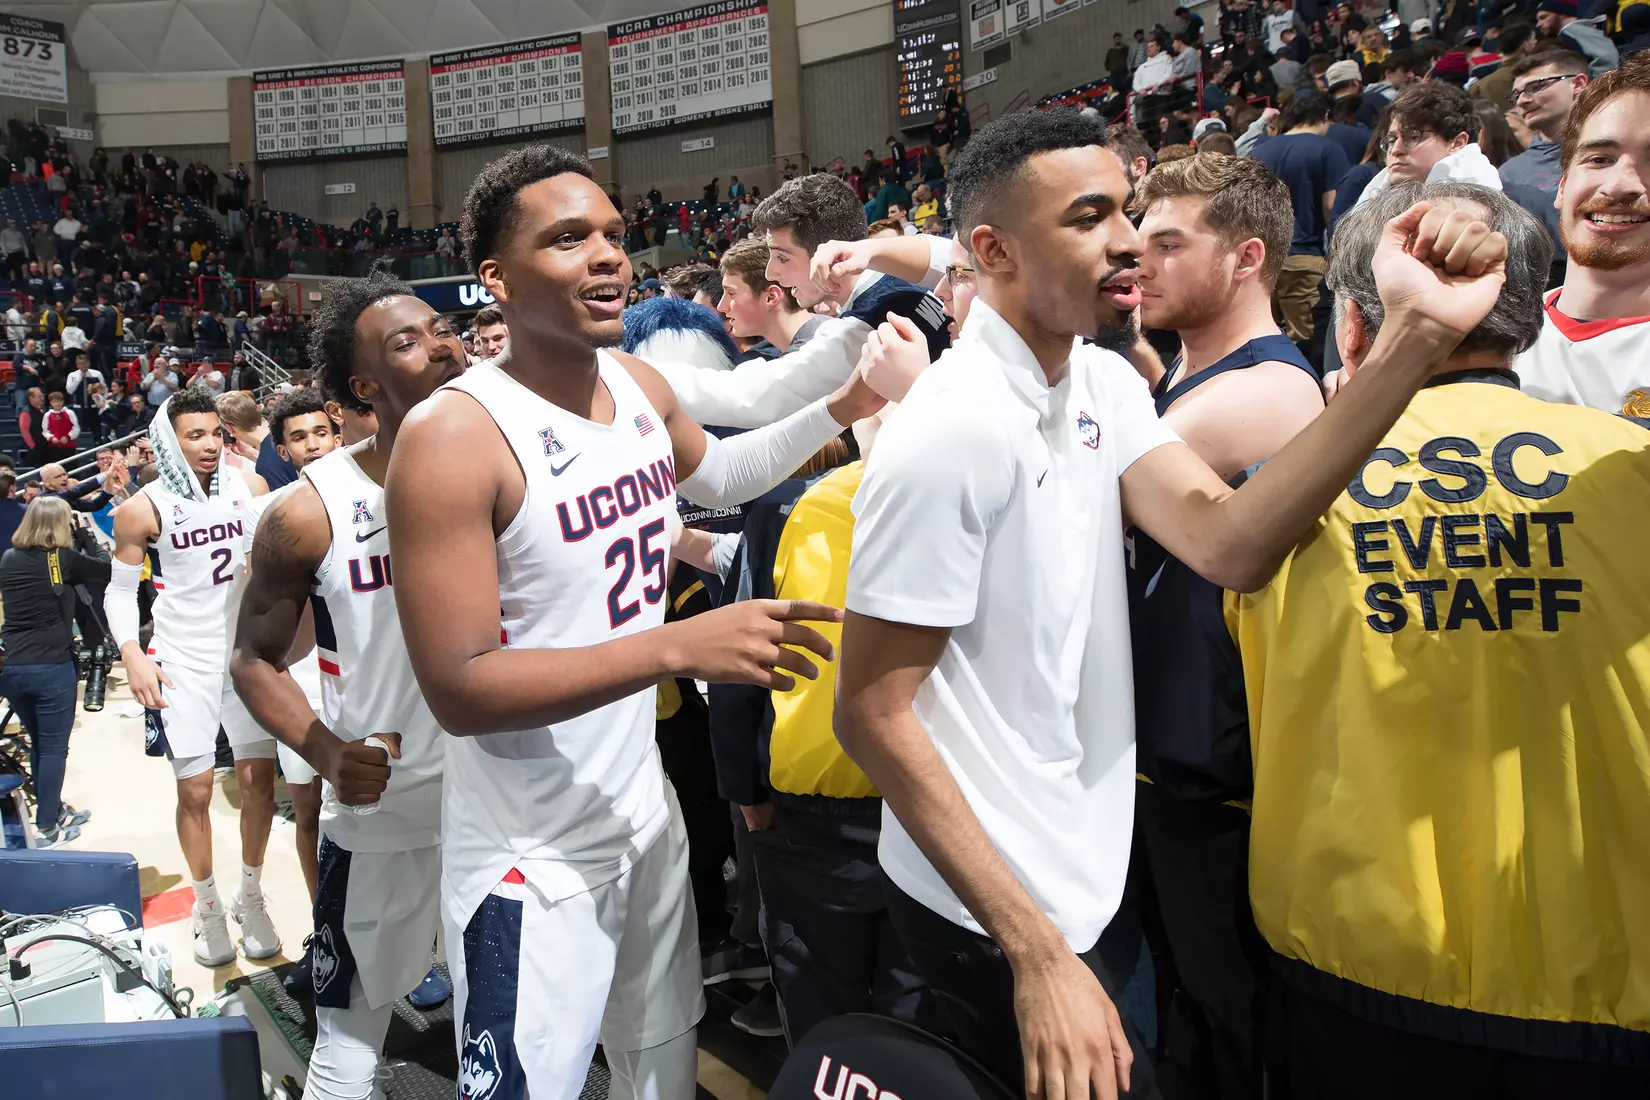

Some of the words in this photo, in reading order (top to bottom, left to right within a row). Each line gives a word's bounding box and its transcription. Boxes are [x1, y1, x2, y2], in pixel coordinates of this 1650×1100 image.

[10, 18, 43, 28] COACH
[616, 25, 681, 43] TOURNAMENT
[686, 7, 760, 28] APPEARANCES
[617, 20, 650, 34] NCAA
[657, 0, 757, 25] CHAMPIONSHIP
[13, 26, 58, 40] CALHOUN
[612, 47, 627, 58] 1989
[634, 42, 650, 53] 1990
[657, 38, 672, 48] 1991
[678, 33, 695, 44] 1992
[702, 28, 718, 39] 1993
[725, 24, 741, 35] 1994
[749, 18, 765, 30] 1995
[4, 37, 52, 60] 873
[444, 56, 506, 71] TOURNAMENT
[511, 47, 567, 61] CHAMPIONS
[470, 48, 502, 58] AMERICAN
[504, 43, 534, 53] ATHLETIC
[536, 35, 578, 48] CONFERENCE
[613, 64, 628, 74] 1996
[635, 59, 650, 70] 1997
[657, 54, 673, 65] 1998
[680, 50, 696, 61] 1999
[702, 45, 720, 56] 2000
[725, 40, 743, 52] 2001
[749, 35, 767, 47] 2002
[294, 69, 326, 77] AMERICAN
[328, 66, 358, 74] ATHLETIC
[360, 63, 401, 71] CONFERENCE
[305, 77, 342, 85] SEASON
[346, 72, 402, 81] CHAMPIONS
[434, 76, 450, 86] 1989
[456, 73, 470, 83] 1991
[477, 69, 492, 79] 1994
[498, 66, 514, 76] 1995
[520, 63, 535, 73] 1996
[542, 59, 557, 69] 1997
[563, 56, 579, 66] 1998
[613, 81, 630, 92] 2003
[635, 76, 652, 87] 2004
[657, 72, 674, 83] 2005
[680, 67, 697, 78] 2006
[703, 62, 720, 73] 2007
[726, 57, 744, 69] 2008
[750, 52, 768, 64] 2009
[980, 70, 998, 83] 201
[258, 92, 272, 102] 1989
[279, 91, 294, 100] 1990
[301, 89, 315, 98] 1991
[322, 87, 337, 97] 1994
[343, 85, 358, 95] 1995
[365, 83, 380, 93] 1996
[387, 81, 402, 91] 1997
[436, 92, 451, 102] 1999
[456, 89, 472, 99] 2000
[478, 86, 493, 96] 2001
[498, 82, 515, 93] 2002
[520, 78, 536, 89] 2005
[542, 75, 559, 86] 2006
[564, 72, 581, 83] 2008
[615, 97, 631, 108] 2010
[637, 93, 652, 104] 2011
[659, 88, 675, 100] 2012
[682, 84, 697, 95] 2013
[704, 79, 721, 91] 2014
[727, 75, 744, 87] 2015
[751, 70, 768, 82] 2016
[258, 108, 273, 117] 1998
[280, 106, 294, 116] 1999
[300, 104, 317, 115] 2000
[322, 103, 338, 112] 2001
[344, 101, 360, 111] 2002
[365, 99, 381, 109] 2003
[387, 97, 404, 108] 2004
[436, 107, 452, 118] 2009
[457, 104, 473, 115] 2010
[478, 102, 494, 112] 2011
[500, 98, 515, 109] 2012
[521, 95, 537, 106] 2014
[543, 92, 559, 102] 2015
[565, 88, 581, 99] 2016
[615, 114, 630, 125] 2017
[638, 110, 653, 121] 2018
[660, 106, 676, 117] 2019
[258, 124, 274, 134] 2007
[280, 122, 296, 132] 2008
[301, 120, 317, 130] 2009
[323, 119, 339, 129] 2010
[345, 117, 360, 127] 2011
[366, 115, 382, 125] 2014
[388, 113, 404, 123] 2015
[437, 124, 452, 134] 2017
[458, 121, 473, 131] 2018
[480, 117, 495, 128] 2019
[616, 119, 671, 134] CONNECTICUT
[674, 111, 711, 123] WOMEN'S
[715, 102, 769, 116] BASKETBALL
[72, 130, 92, 138] 223
[259, 140, 274, 150] 2016
[281, 138, 296, 148] 2017
[302, 136, 317, 146] 2018
[324, 135, 339, 144] 2019
[436, 132, 490, 145] CONNECTICUT
[493, 127, 530, 137] WOMEN'S
[533, 119, 585, 131] BASKETBALL
[700, 139, 711, 147] 14
[258, 151, 312, 160] CONNECTICUT
[316, 147, 352, 155] WOMEN'S
[355, 143, 407, 152] BASKETBALL
[343, 184, 352, 192] 12
[1346, 432, 1570, 509] CSC
[556, 454, 677, 544] UCONN
[1352, 511, 1574, 573] EVENT
[212, 548, 234, 586] 2
[349, 554, 392, 592] U
[604, 516, 666, 630] 25
[1365, 578, 1582, 634] STAFF
[814, 1054, 902, 1100] UC
